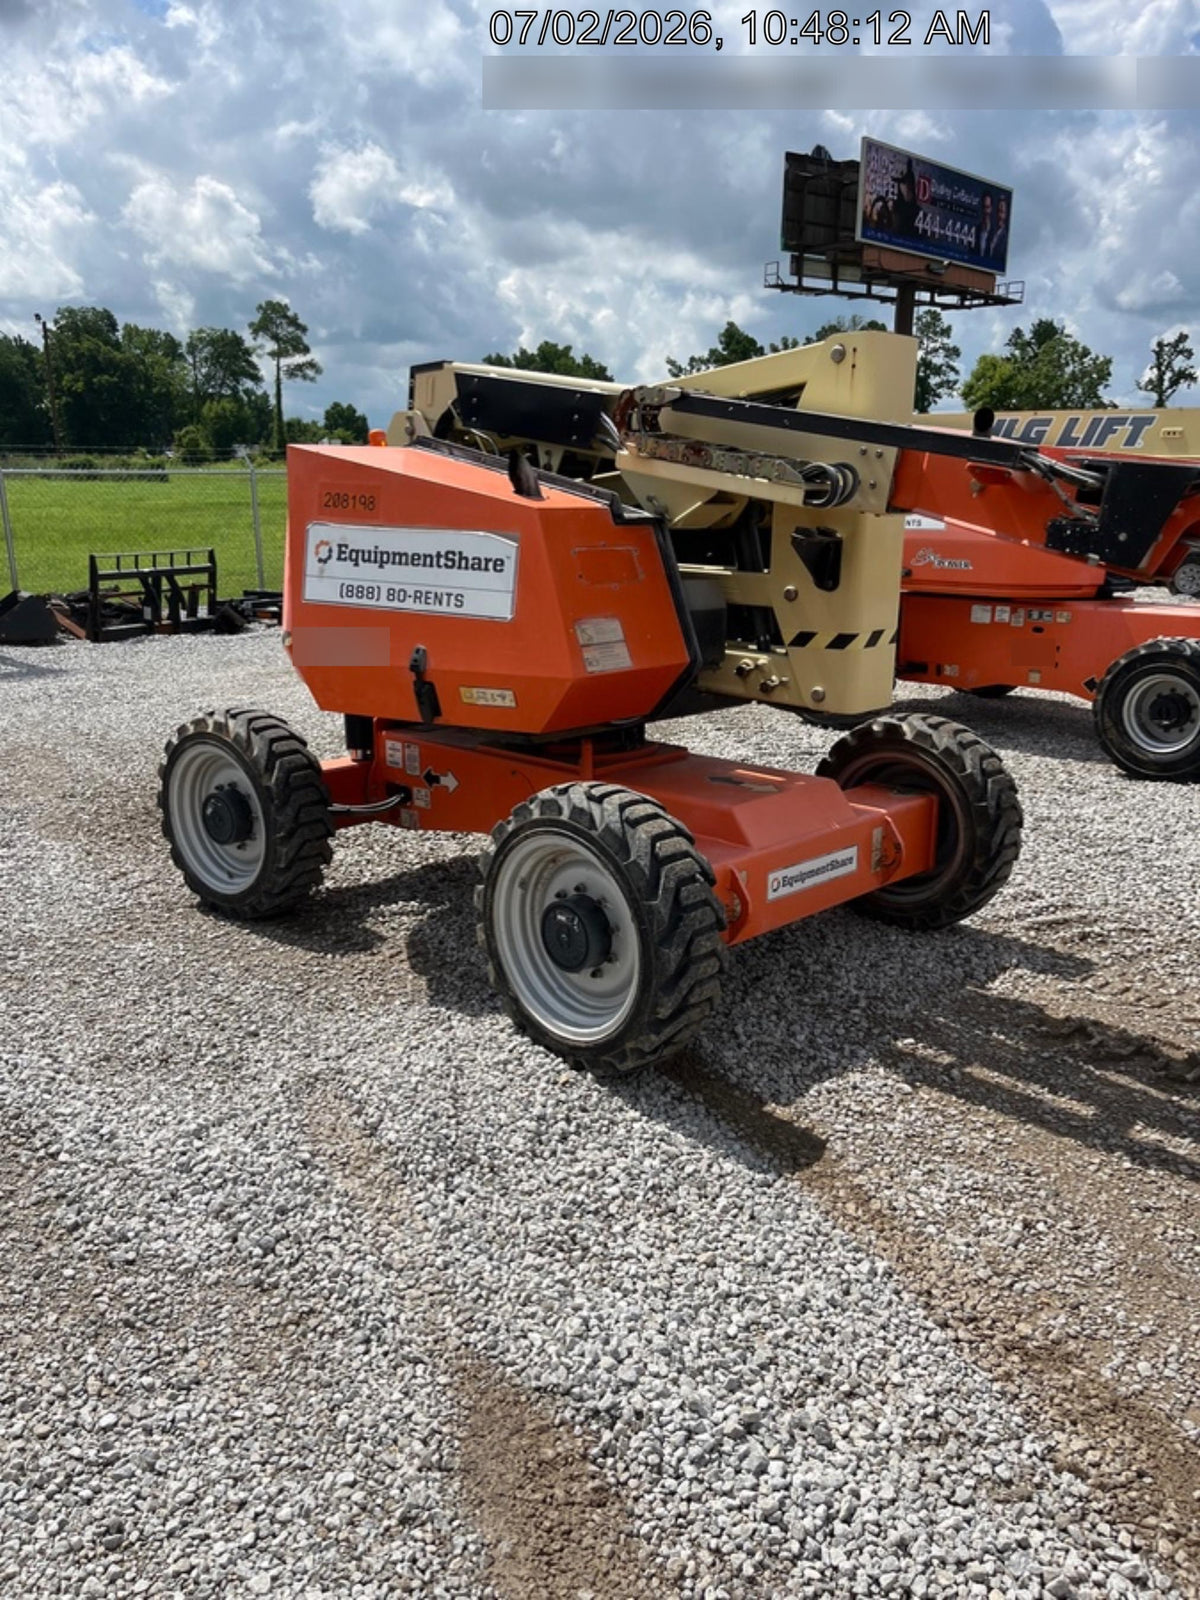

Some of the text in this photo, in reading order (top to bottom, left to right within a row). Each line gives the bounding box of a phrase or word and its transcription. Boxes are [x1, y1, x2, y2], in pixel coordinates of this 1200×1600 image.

[914, 210, 976, 248] 444-4444
[1057, 416, 1156, 447] LIFT
[323, 491, 376, 511] 208198
[336, 543, 505, 573] EquipmentShare
[339, 583, 465, 608] (888) 80-RENTS
[782, 856, 854, 888] EquipmentShare
